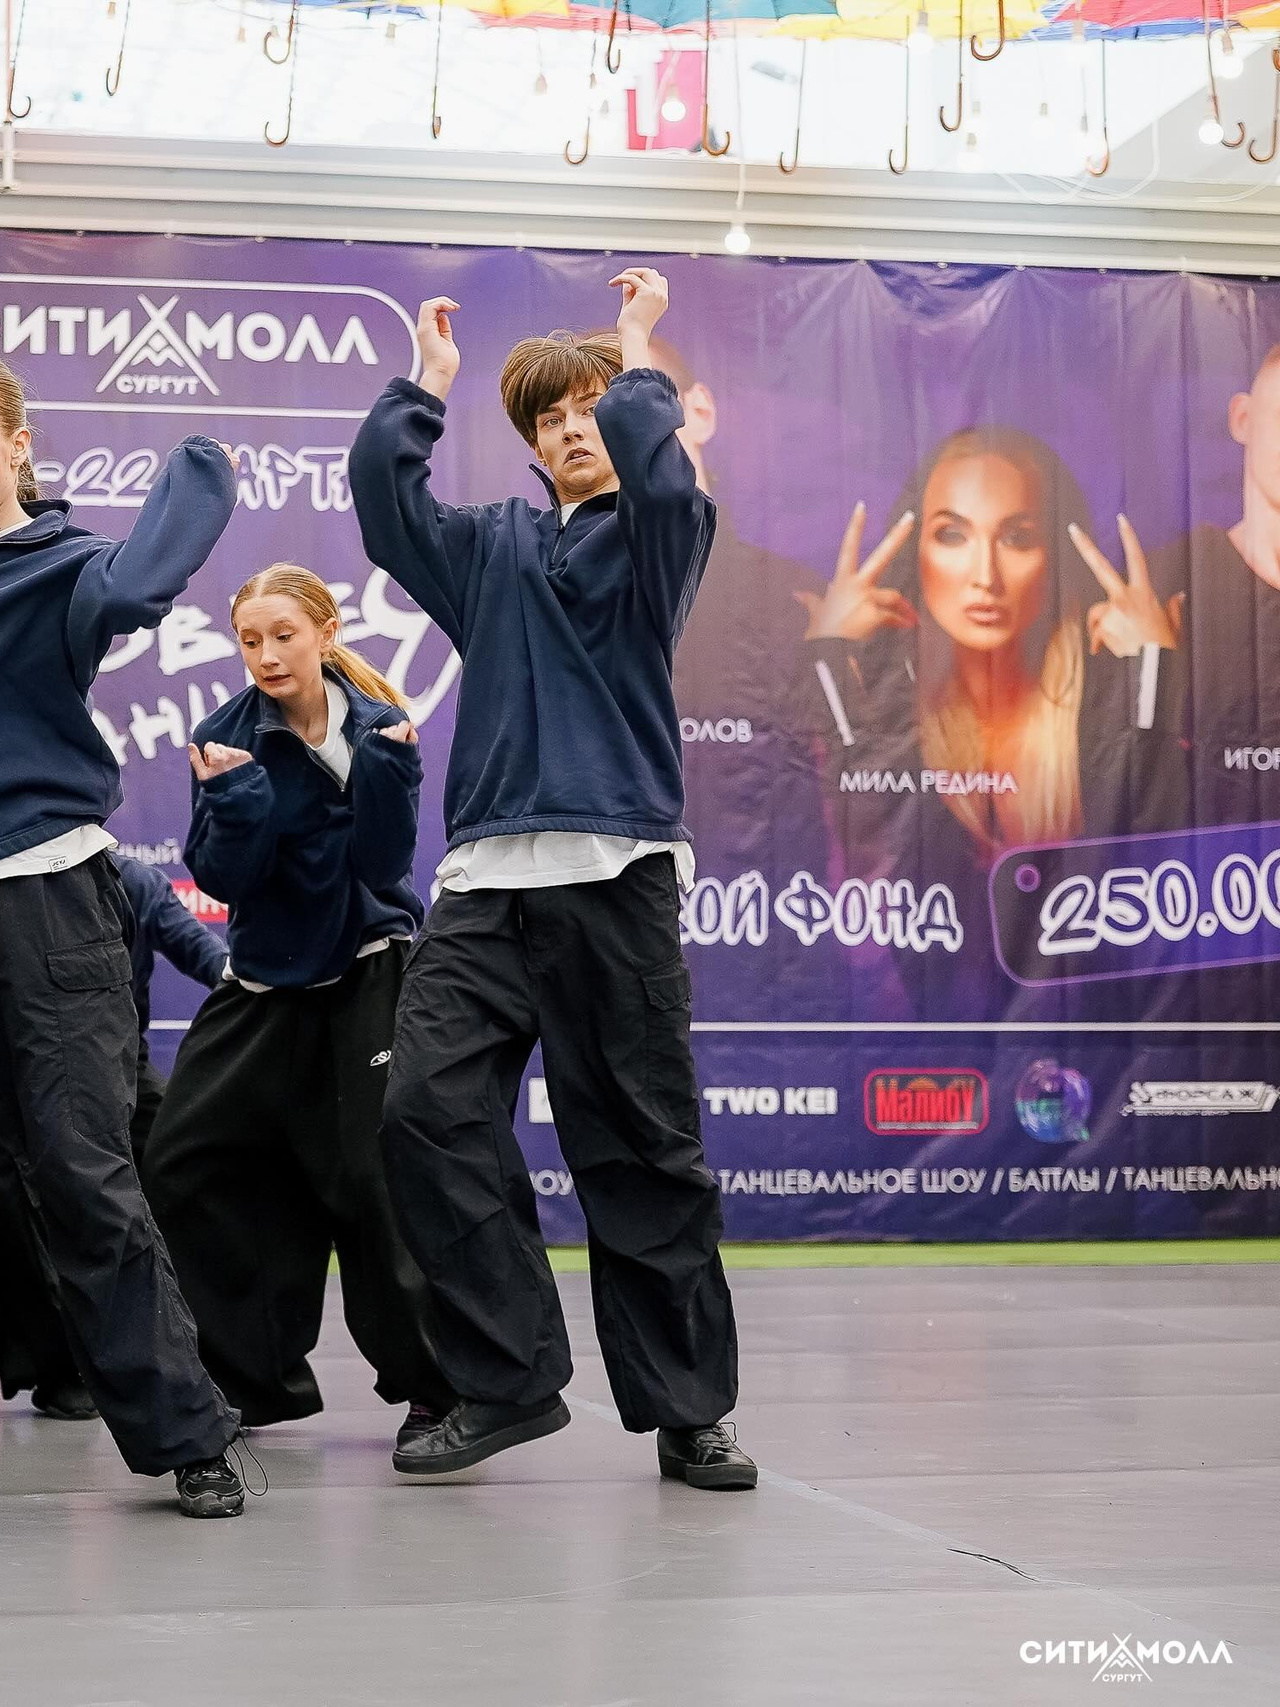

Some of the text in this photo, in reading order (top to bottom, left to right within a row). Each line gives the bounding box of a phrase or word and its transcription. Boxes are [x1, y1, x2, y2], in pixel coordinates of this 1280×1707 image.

[185, 310, 380, 366] МОЛЛ
[117, 375, 202, 396] СУРГУТ
[33, 443, 355, 512] -22 АРТ
[678, 717, 754, 743] ОЛОВ
[839, 769, 1018, 795] МИЛА РЕДИНА
[774, 870, 964, 953] ФОНД
[702, 1086, 839, 1116] TWO KEI
[531, 1168, 573, 1196] ОУ
[718, 1167, 918, 1196] ТАНЦЕВАЛЬНОЕ
[921, 1167, 987, 1194] ШОУ
[1008, 1166, 1101, 1193] БАТТЛЫ
[1121, 1166, 1280, 1194] ТАНЦЕВАЛЬН
